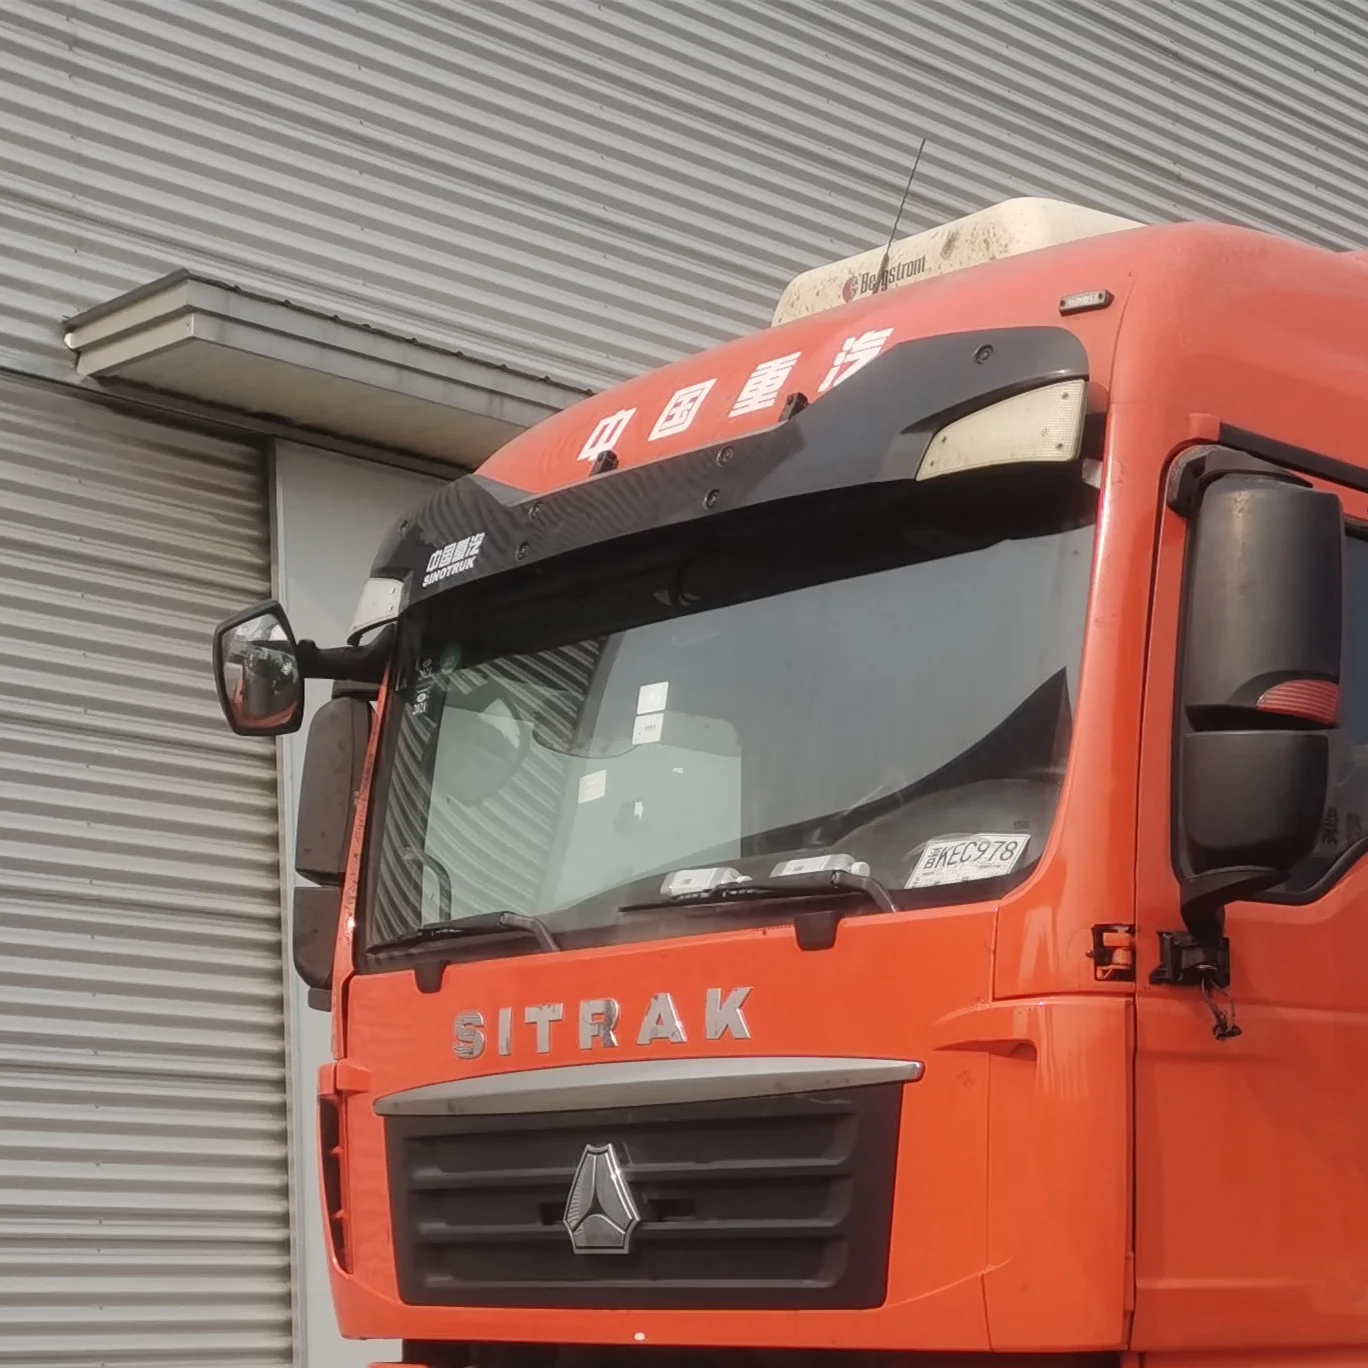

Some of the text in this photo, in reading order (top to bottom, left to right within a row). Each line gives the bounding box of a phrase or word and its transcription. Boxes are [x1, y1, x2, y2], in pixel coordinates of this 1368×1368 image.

[577, 327, 894, 462] 中国重汽
[422, 556, 477, 588] SINOTRUK
[426, 532, 486, 573] 中国重汽
[452, 986, 754, 1060] SITRAK
